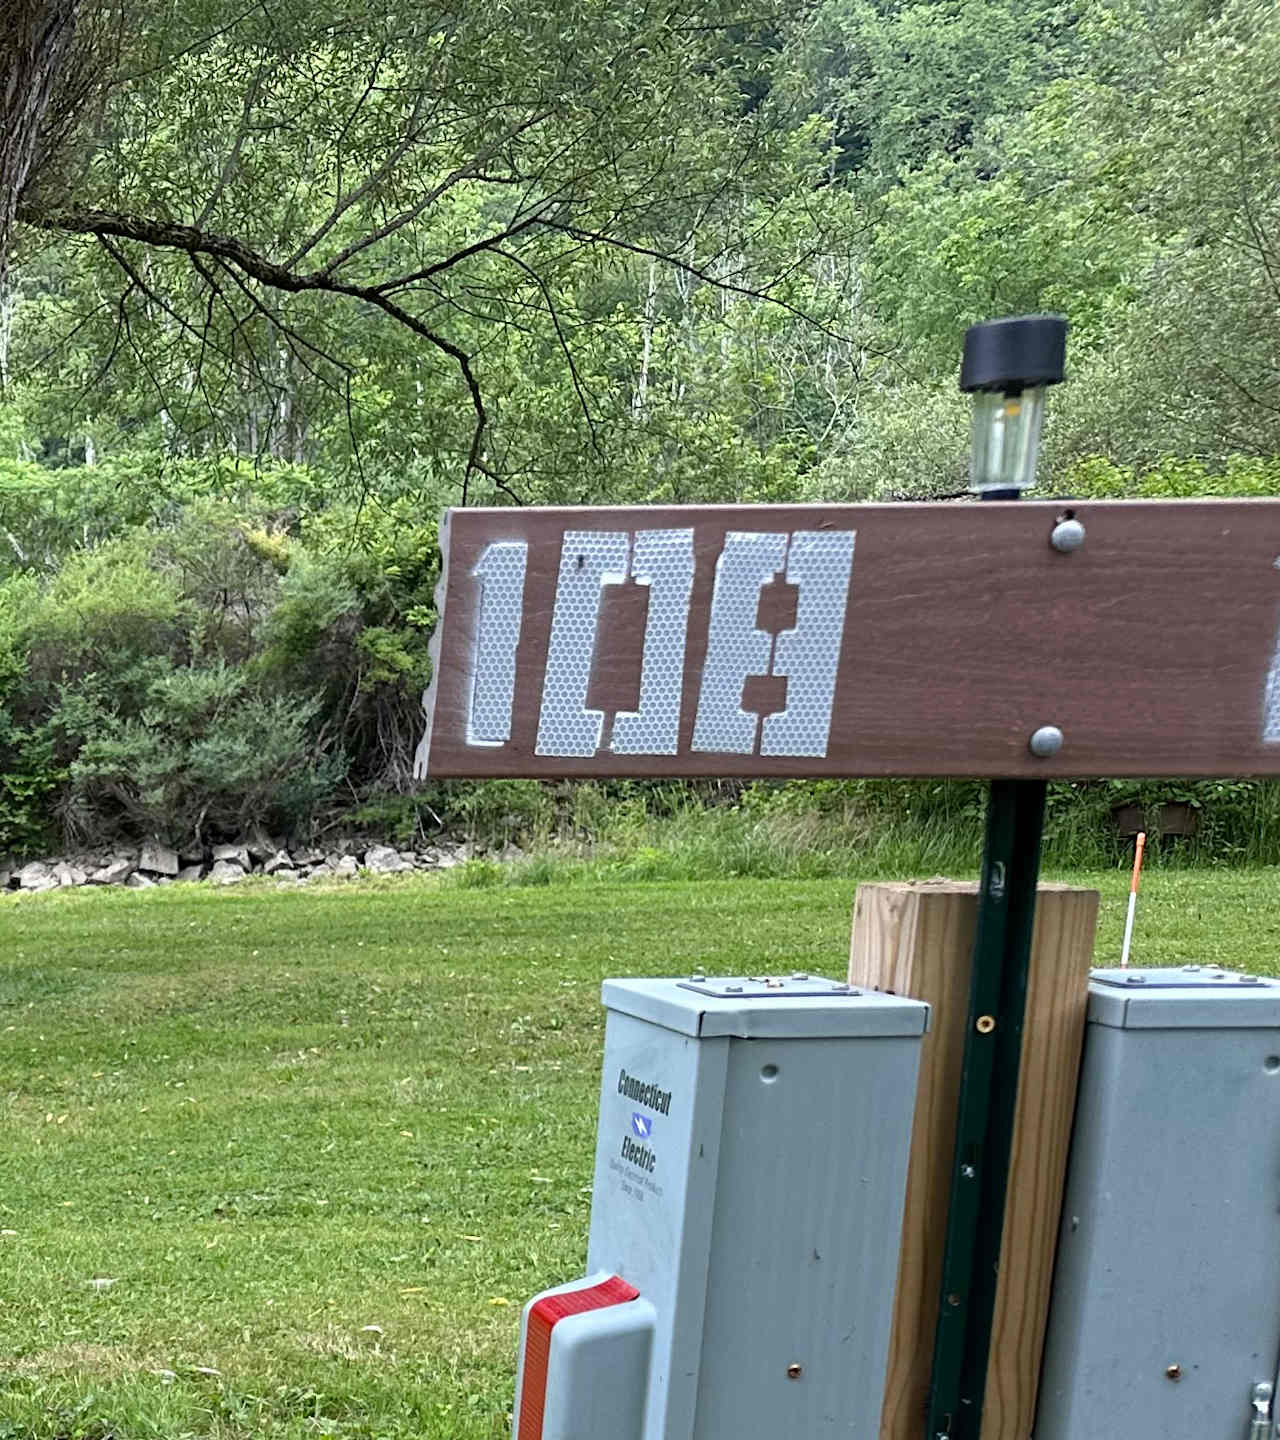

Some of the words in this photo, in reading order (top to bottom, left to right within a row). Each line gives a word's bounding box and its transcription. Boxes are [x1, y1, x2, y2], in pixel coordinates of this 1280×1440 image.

[465, 528, 857, 758] 108
[617, 1068, 672, 1117] Connecticut
[621, 1135, 657, 1174] Electric
